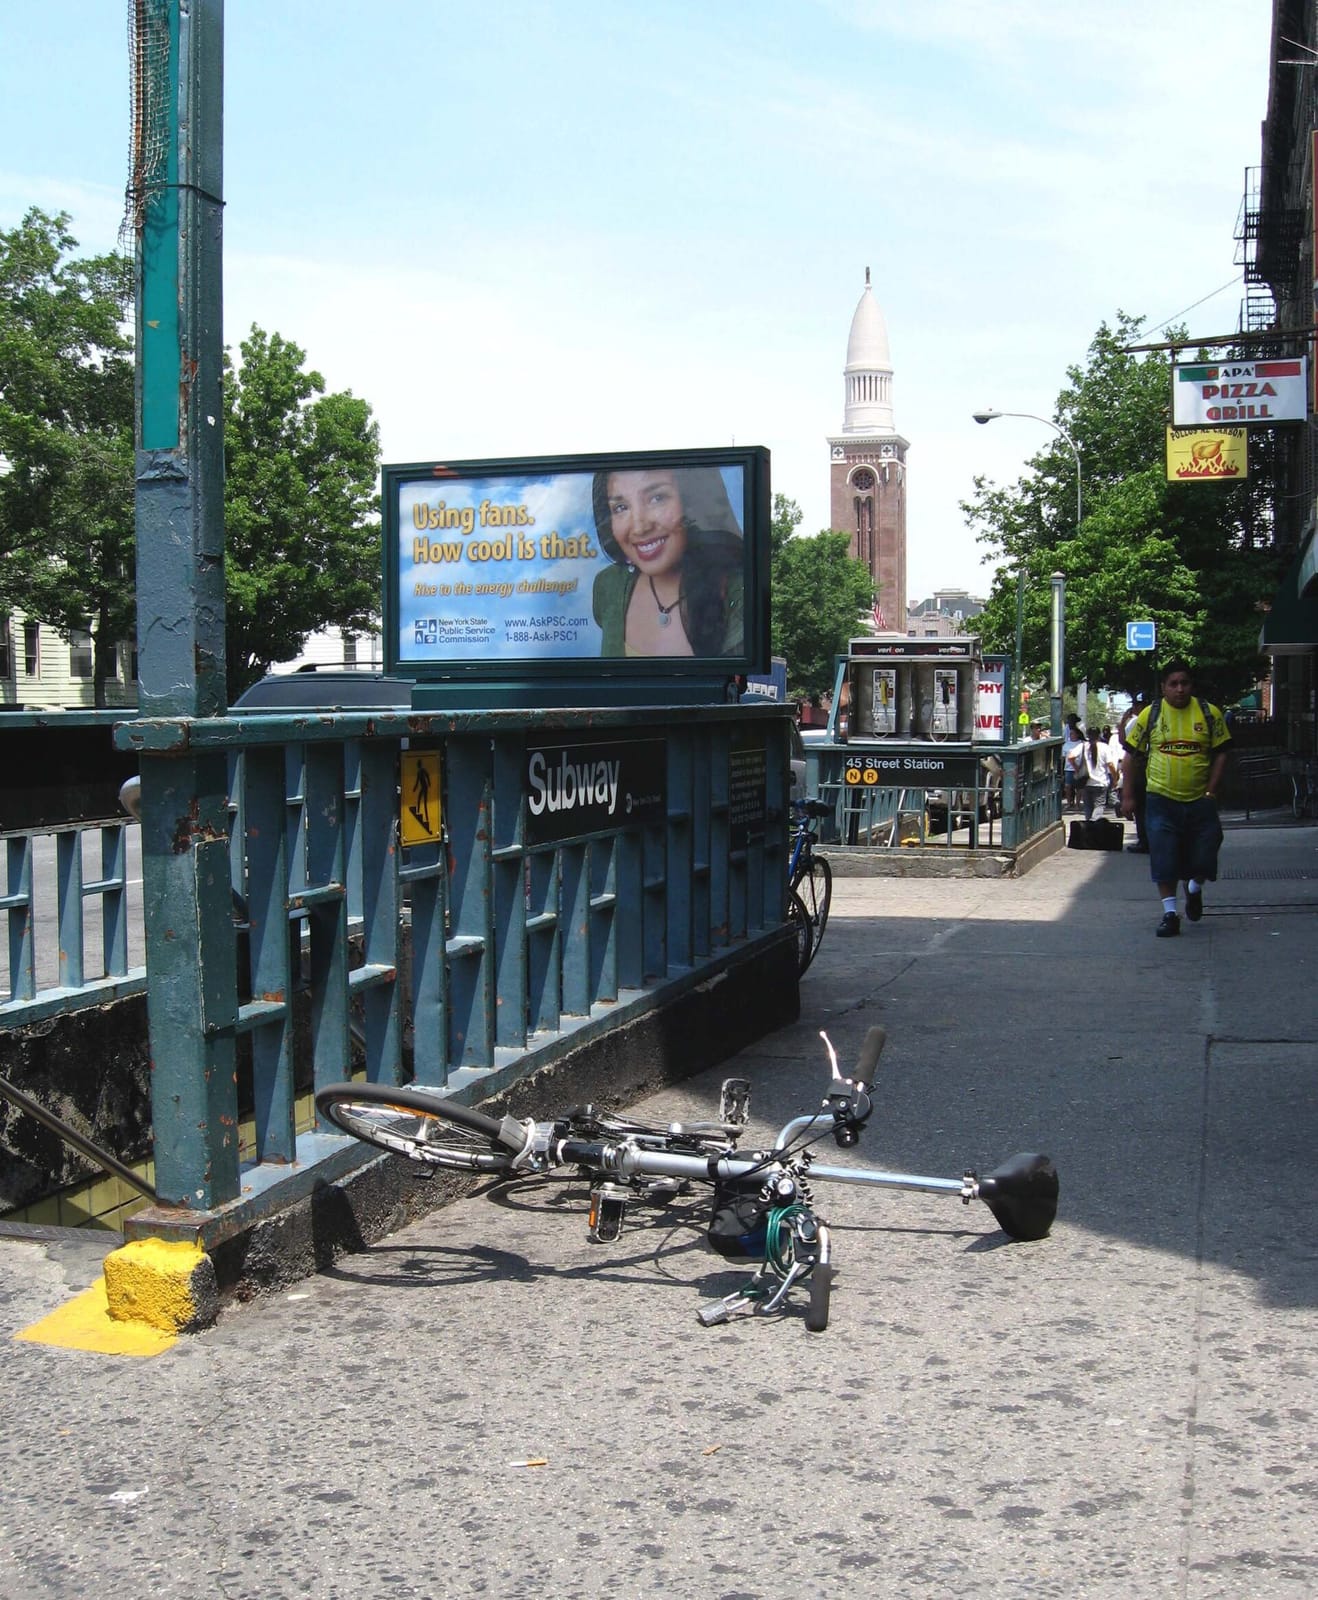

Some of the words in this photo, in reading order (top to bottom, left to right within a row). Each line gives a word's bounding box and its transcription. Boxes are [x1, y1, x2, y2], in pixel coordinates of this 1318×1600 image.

[1207, 366, 1265, 379] PAPA'
[1202, 382, 1277, 399] PIZZA
[1206, 404, 1273, 420] GRILL
[413, 501, 474, 534] Using
[479, 499, 535, 526] fans.
[413, 536, 463, 563] How
[467, 533, 512, 560] cool
[518, 534, 535, 560] is
[541, 531, 596, 558] that.
[414, 583, 438, 596] Rise
[440, 583, 452, 596] to
[455, 581, 472, 595] the
[476, 583, 513, 598] energy
[517, 579, 577, 596] challenge!
[455, 618, 469, 626] York
[470, 618, 487, 626] State
[505, 618, 588, 628] www.AskPSC.com
[439, 626, 464, 635] Public
[465, 625, 496, 634] Service
[439, 635, 489, 644] Commission
[506, 632, 578, 642] 1-888-Ask-PSC1
[846, 758, 862, 768] 45
[865, 758, 900, 769] Street
[903, 758, 944, 769] Station
[528, 751, 620, 816] Subway
